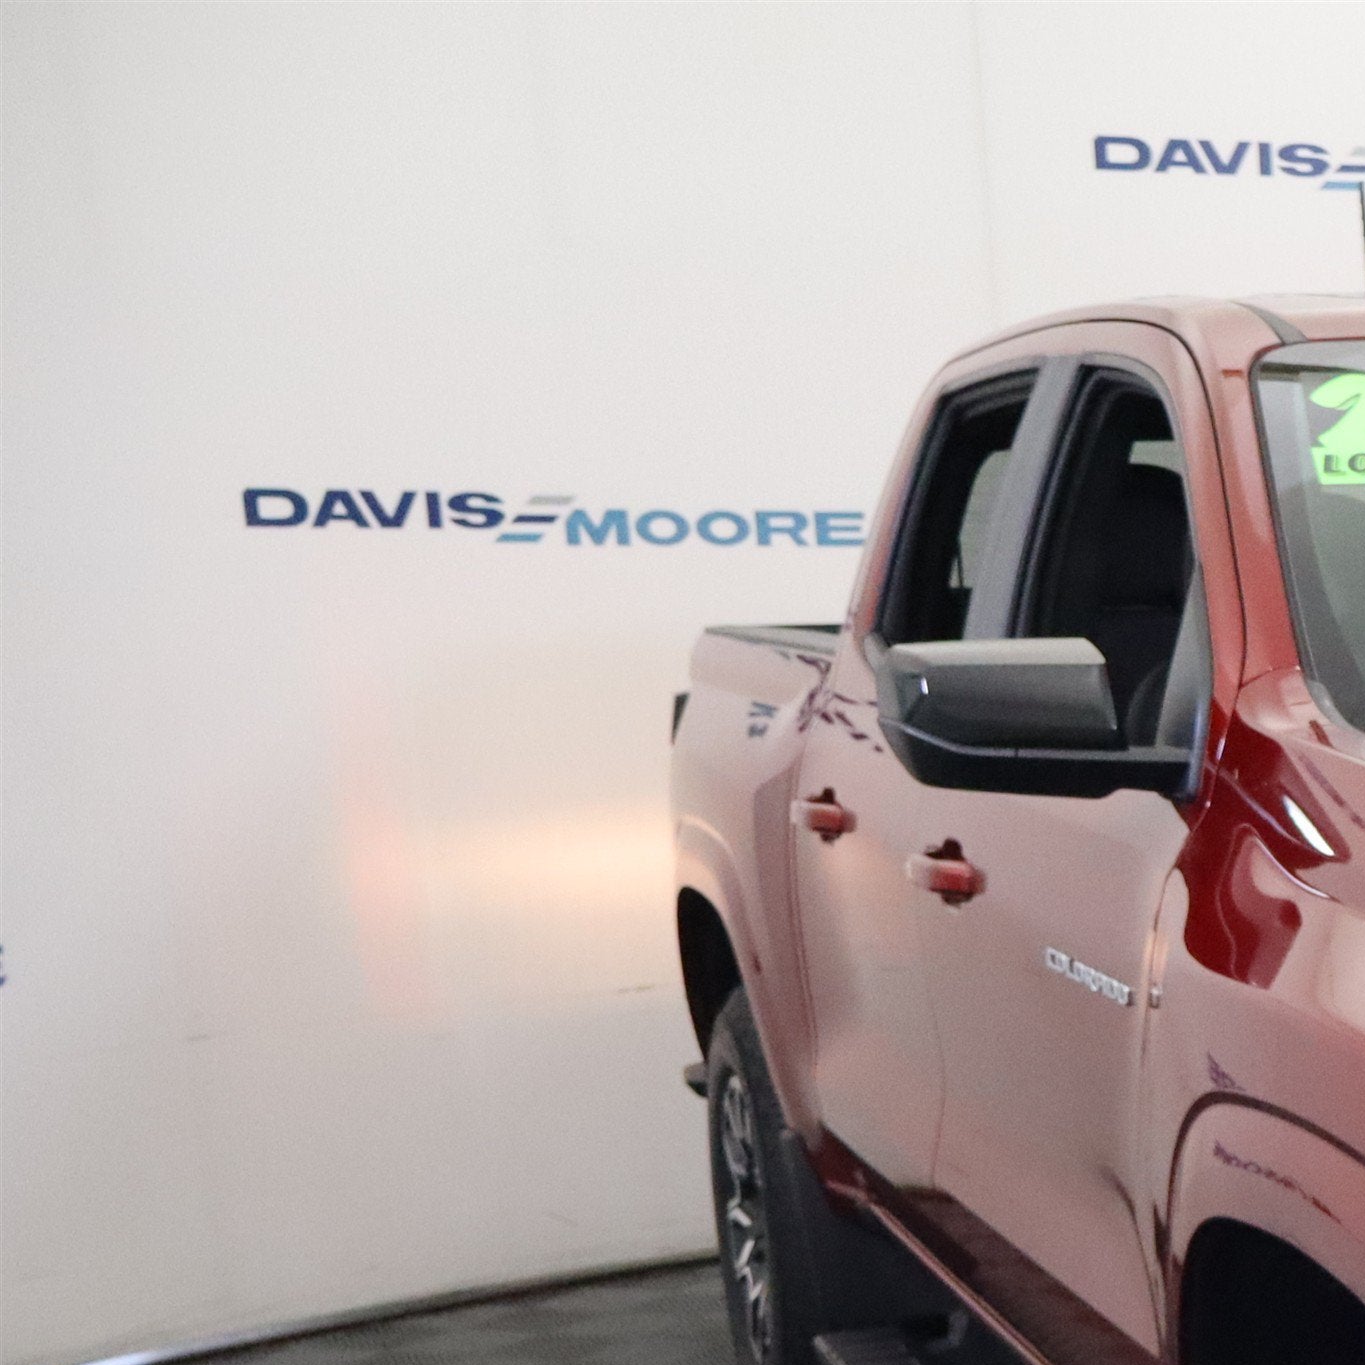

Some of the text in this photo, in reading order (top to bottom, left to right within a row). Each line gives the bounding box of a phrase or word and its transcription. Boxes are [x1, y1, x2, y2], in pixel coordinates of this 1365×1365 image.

[1093, 135, 1329, 177] DAVIS
[242, 488, 866, 547] DAVIS MOORE
